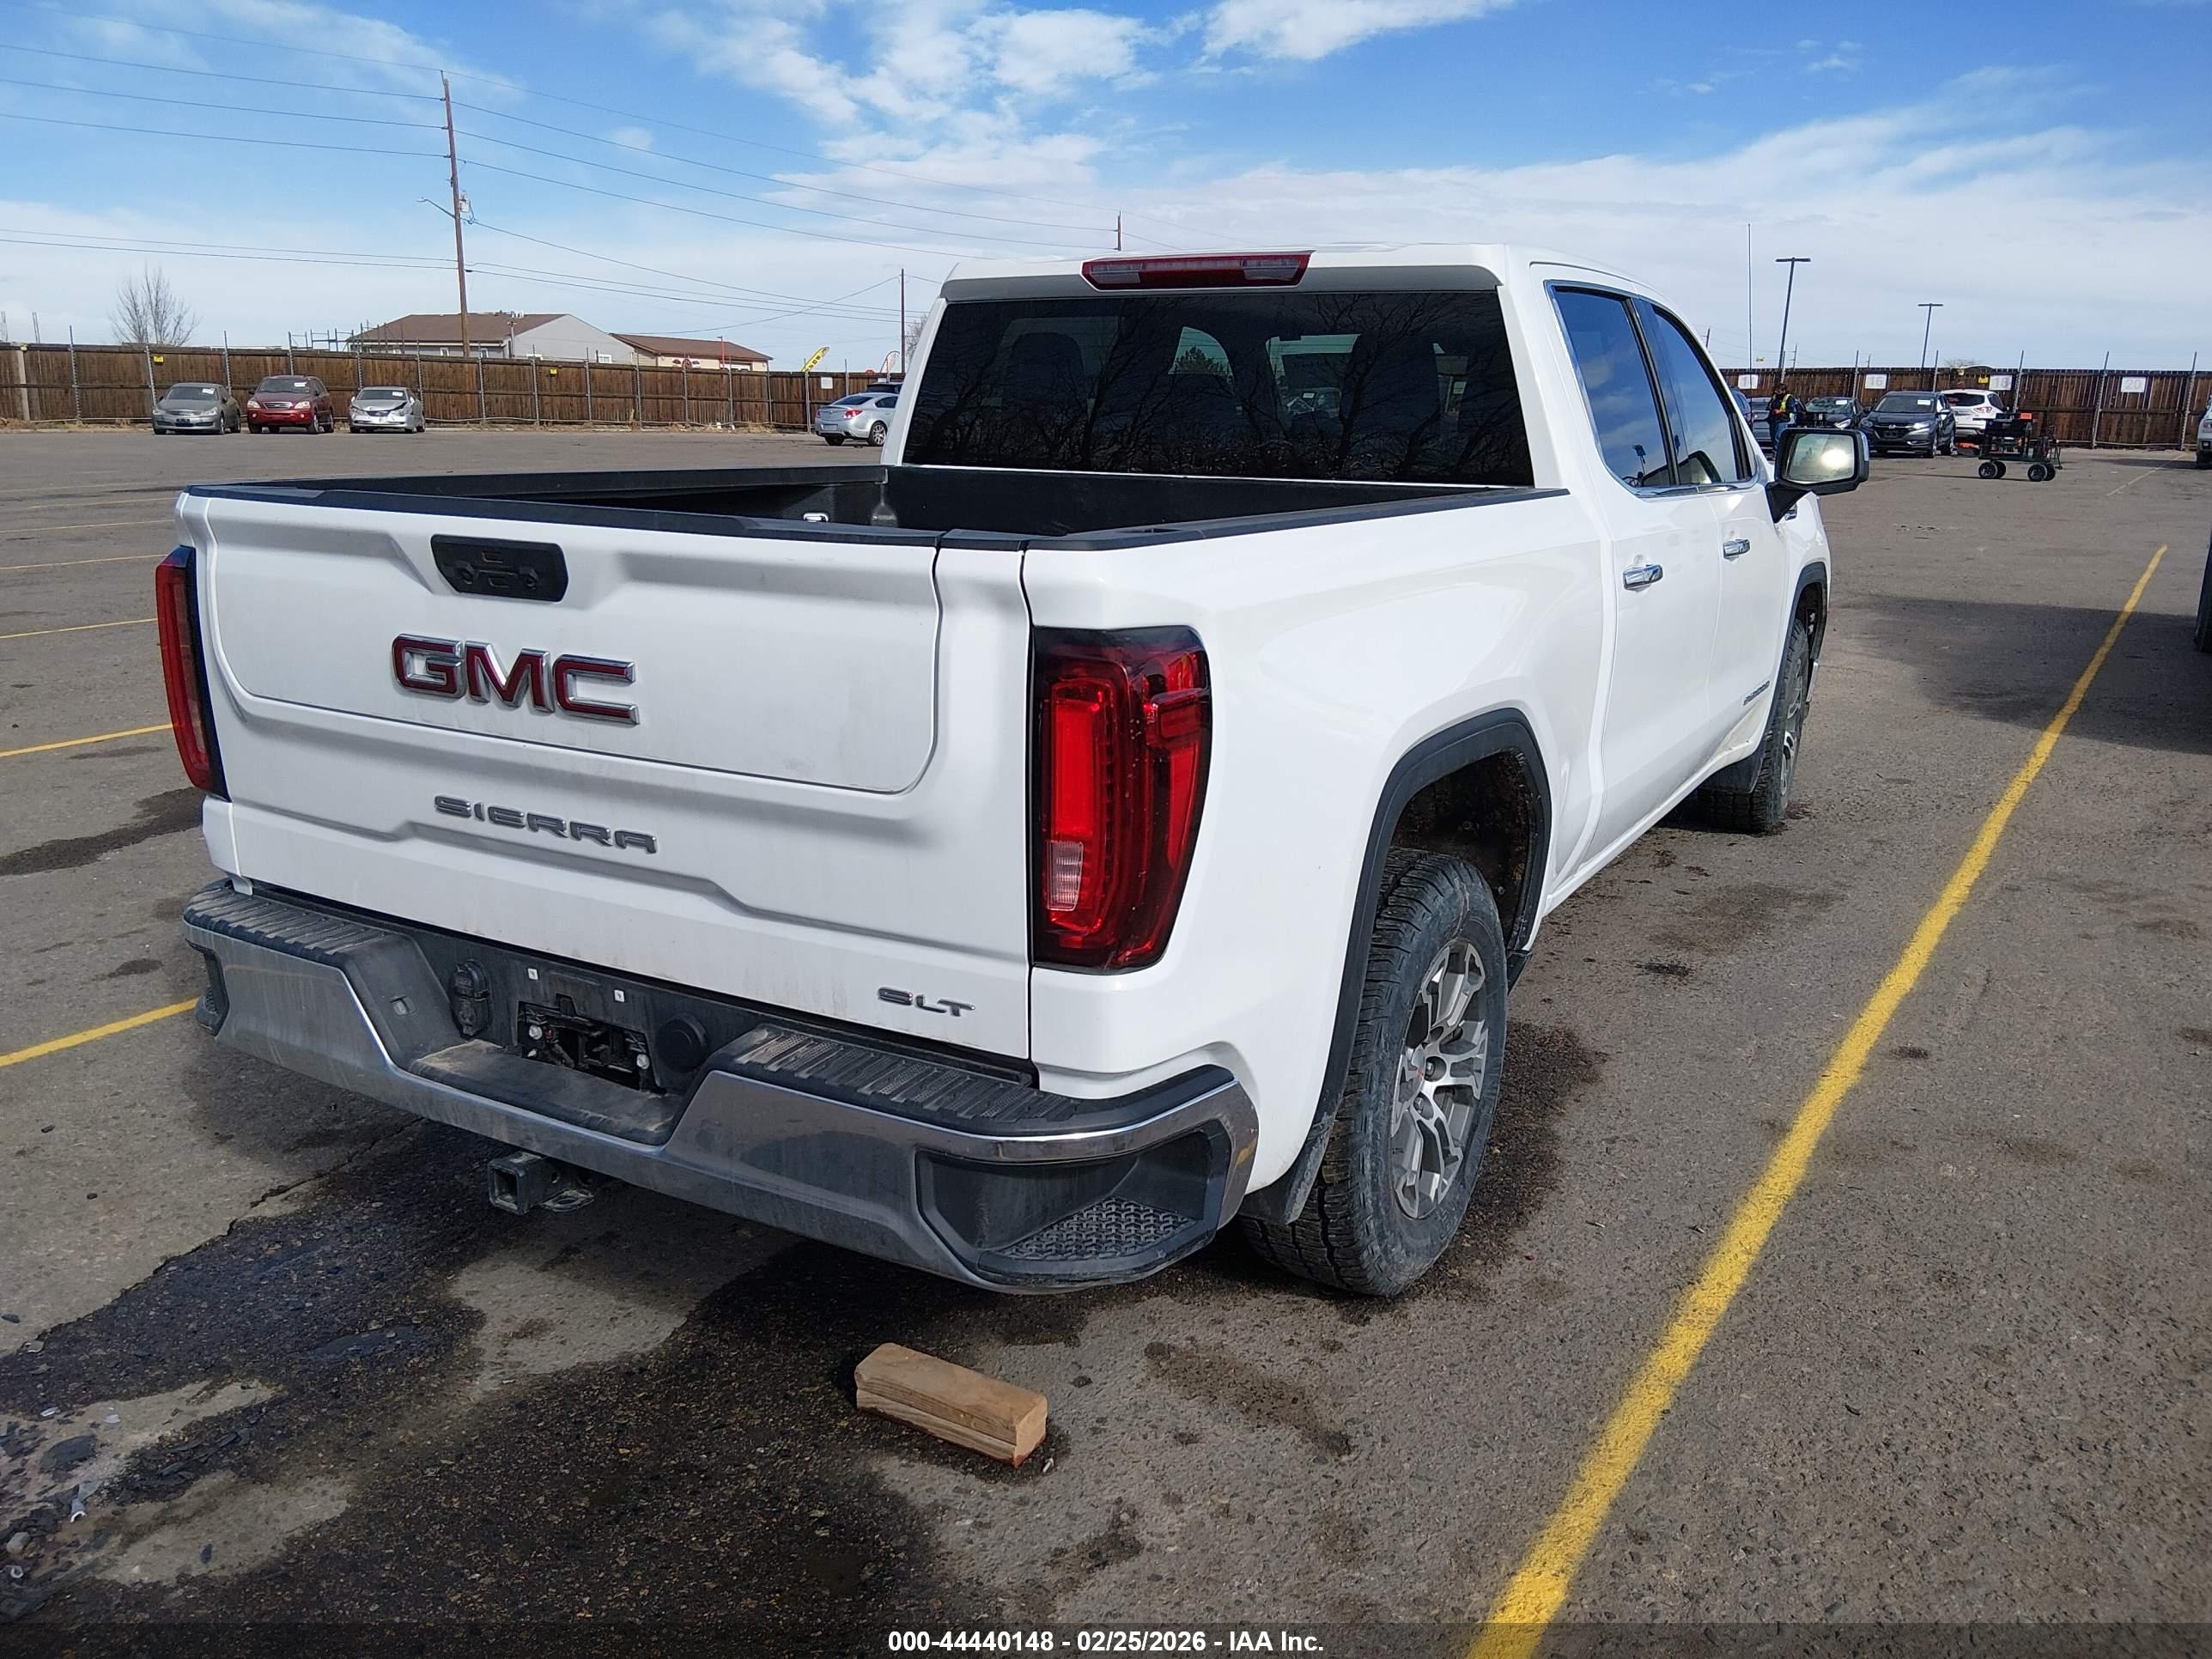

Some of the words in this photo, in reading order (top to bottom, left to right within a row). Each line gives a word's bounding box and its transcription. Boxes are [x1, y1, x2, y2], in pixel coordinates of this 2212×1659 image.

[1869, 376, 1883, 386] 16
[1994, 377, 2008, 388] 18
[2125, 379, 2142, 390] 20
[392, 633, 640, 726] GMC
[434, 795, 658, 854] SIERRA
[878, 987, 976, 1017] SLT
